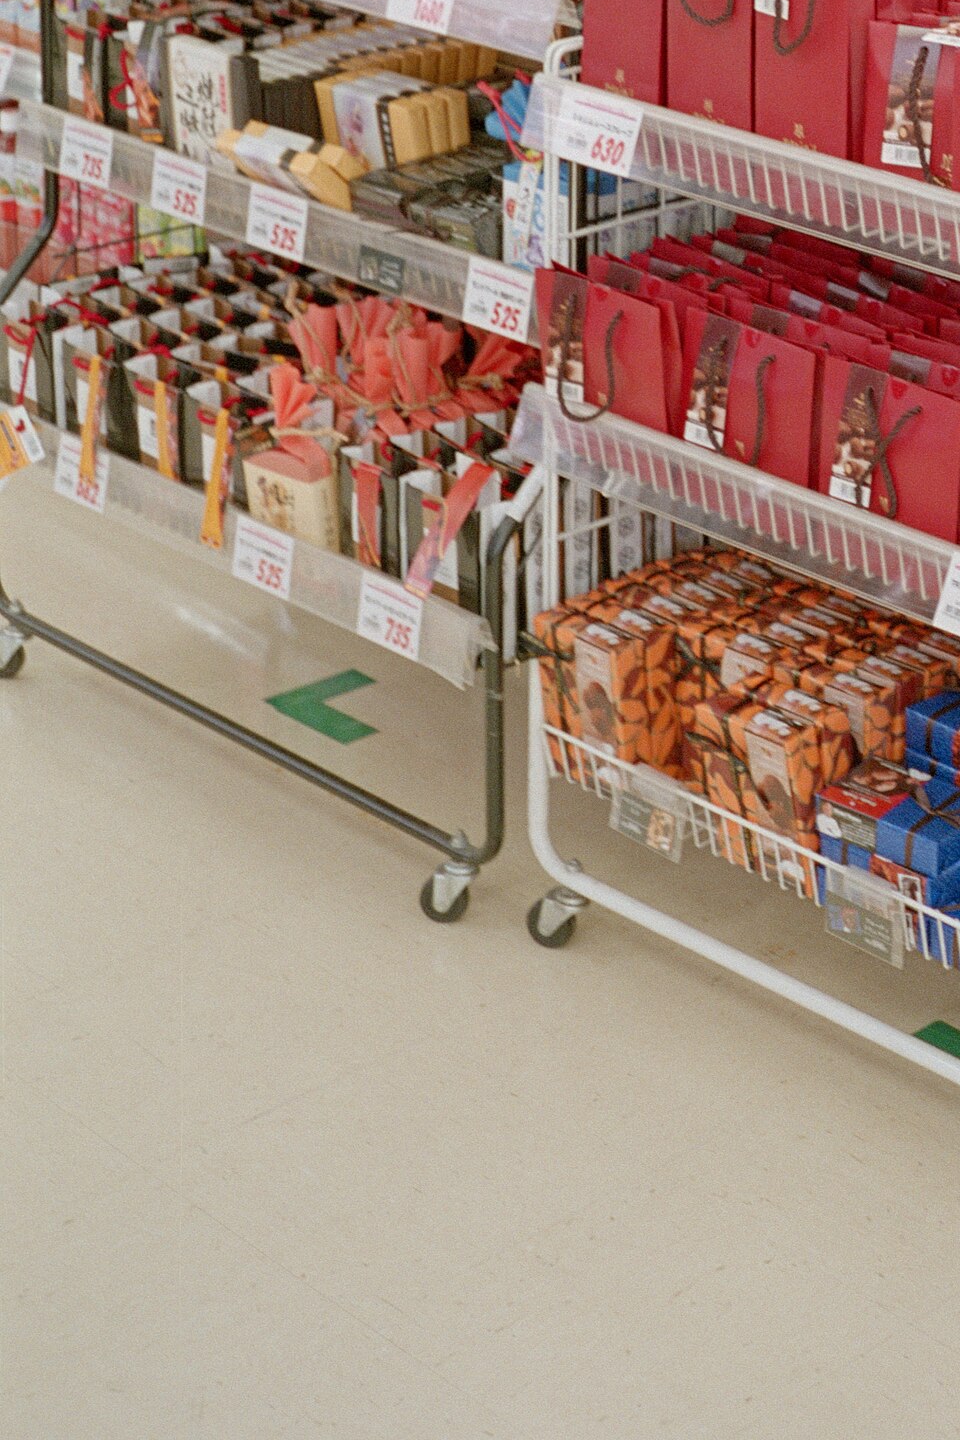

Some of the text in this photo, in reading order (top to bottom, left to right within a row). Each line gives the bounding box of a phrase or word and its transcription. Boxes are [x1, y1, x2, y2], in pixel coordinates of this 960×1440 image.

[590, 133, 625, 167] 630
[172, 188, 198, 215] 525
[270, 224, 298, 252] 525
[490, 301, 522, 333] 525
[256, 559, 283, 589] 525
[385, 618, 413, 649] 735
